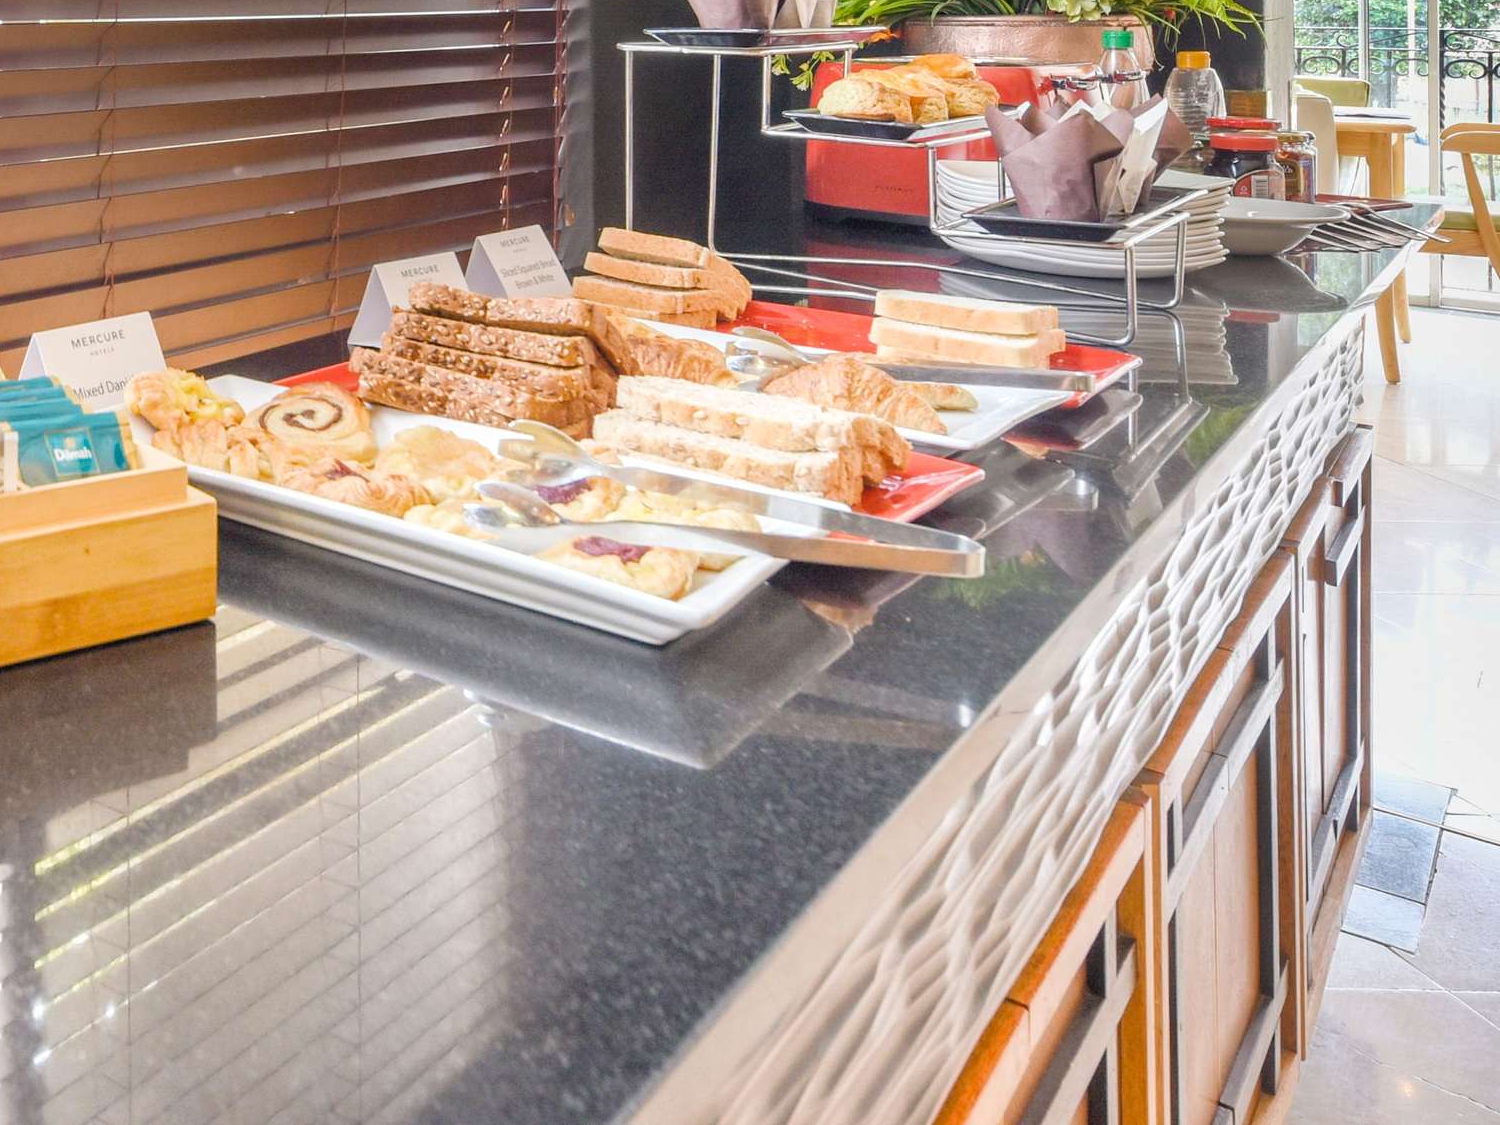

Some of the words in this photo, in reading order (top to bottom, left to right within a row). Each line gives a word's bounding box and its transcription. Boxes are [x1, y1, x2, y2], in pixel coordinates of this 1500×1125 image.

[400, 264, 440, 277] MERCURE
[71, 329, 125, 349] MERCURE
[73, 382, 105, 401] Mixed
[105, 374, 134, 394] Dani
[54, 448, 93, 461] Dilmah
